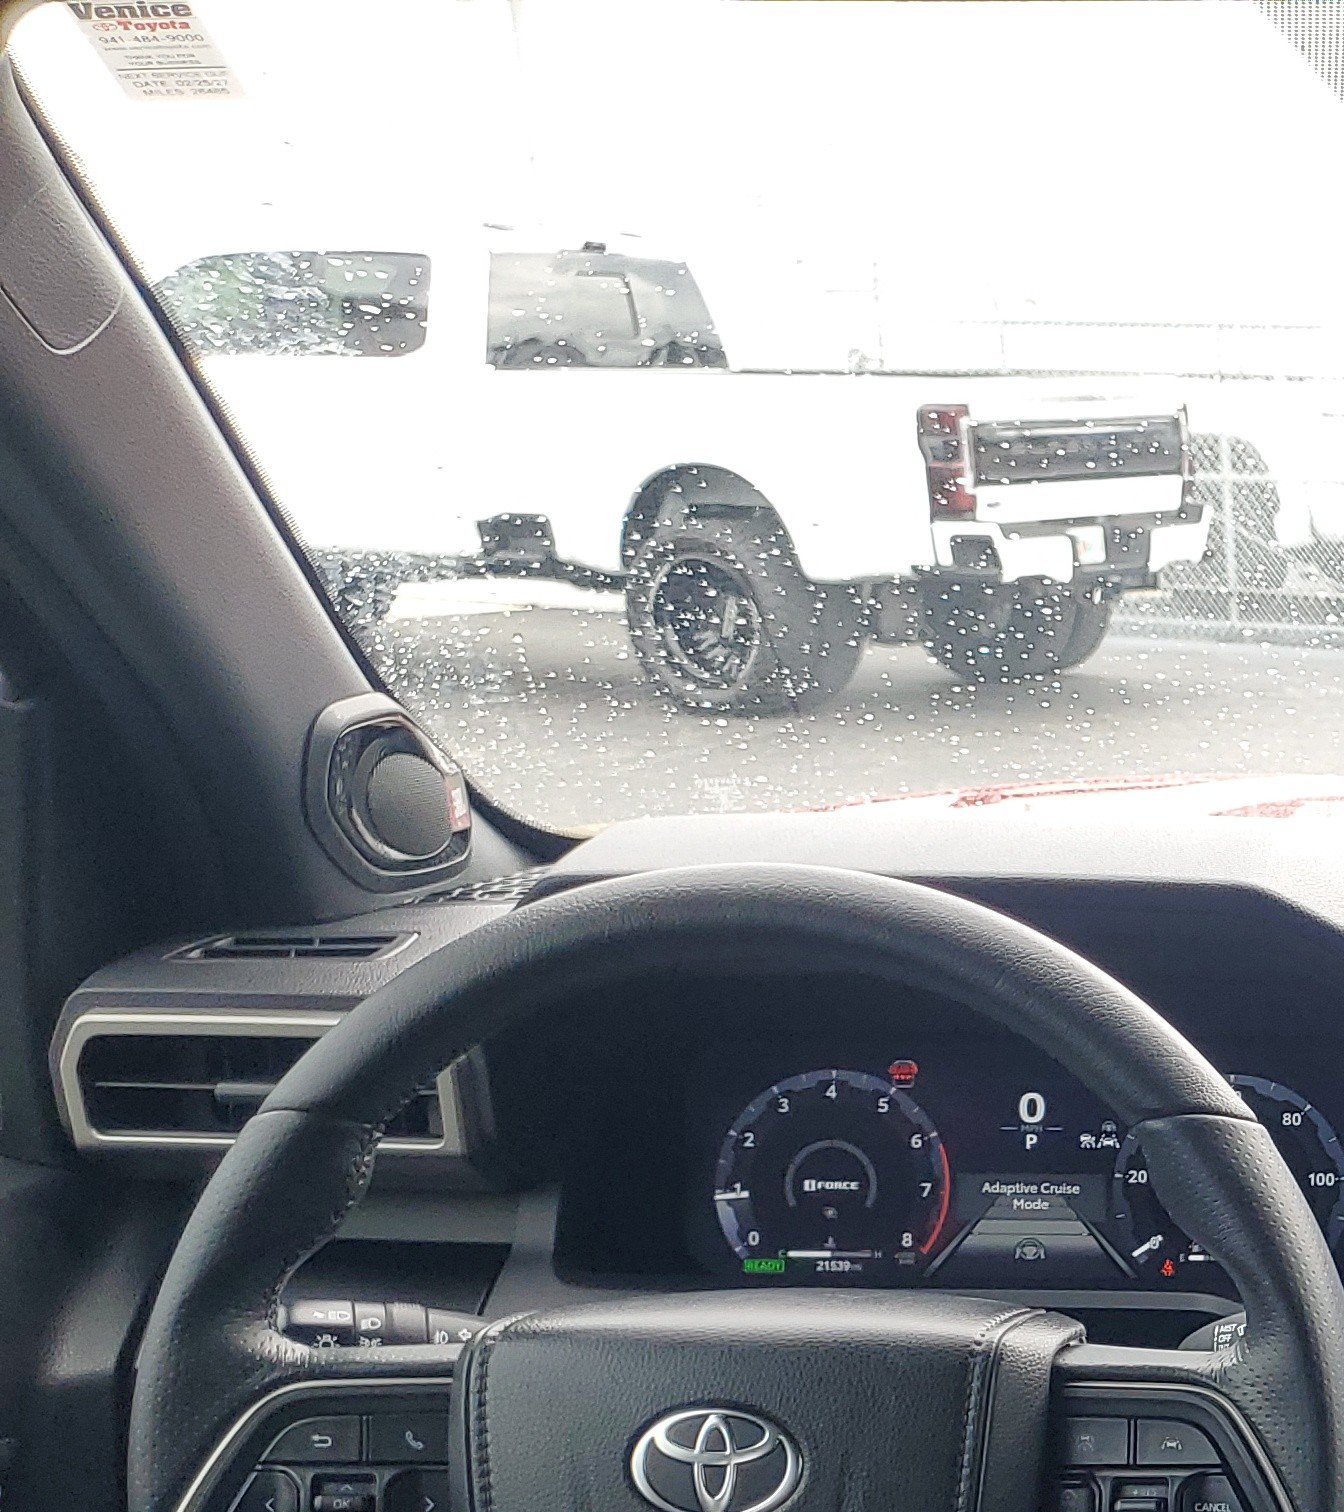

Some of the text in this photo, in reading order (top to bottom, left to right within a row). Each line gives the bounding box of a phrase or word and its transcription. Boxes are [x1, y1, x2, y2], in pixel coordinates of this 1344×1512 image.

[68, 1, 192, 20] Venice
[117, 20, 191, 32] Toyota
[99, 34, 204, 45] 941-484-9000
[825, 1084, 838, 1100] 4
[778, 1098, 790, 1114] 3
[877, 1098, 890, 1114] 5
[1018, 1092, 1046, 1124] 0
[1282, 1113, 1302, 1126] 80
[743, 1133, 755, 1148] 2
[910, 1134, 923, 1149] 6
[1025, 1134, 1038, 1150] P
[1127, 1170, 1148, 1184] 20
[1308, 1173, 1336, 1187] 100
[919, 1183, 932, 1198] 7
[982, 1182, 1081, 1197] Adaptive Cruise
[1013, 1199, 1050, 1211] Mode
[748, 1232, 761, 1247] 0
[901, 1232, 914, 1248] 8
[333, 1499, 351, 1509] OK
[1194, 1502, 1232, 1512] CANCEL
